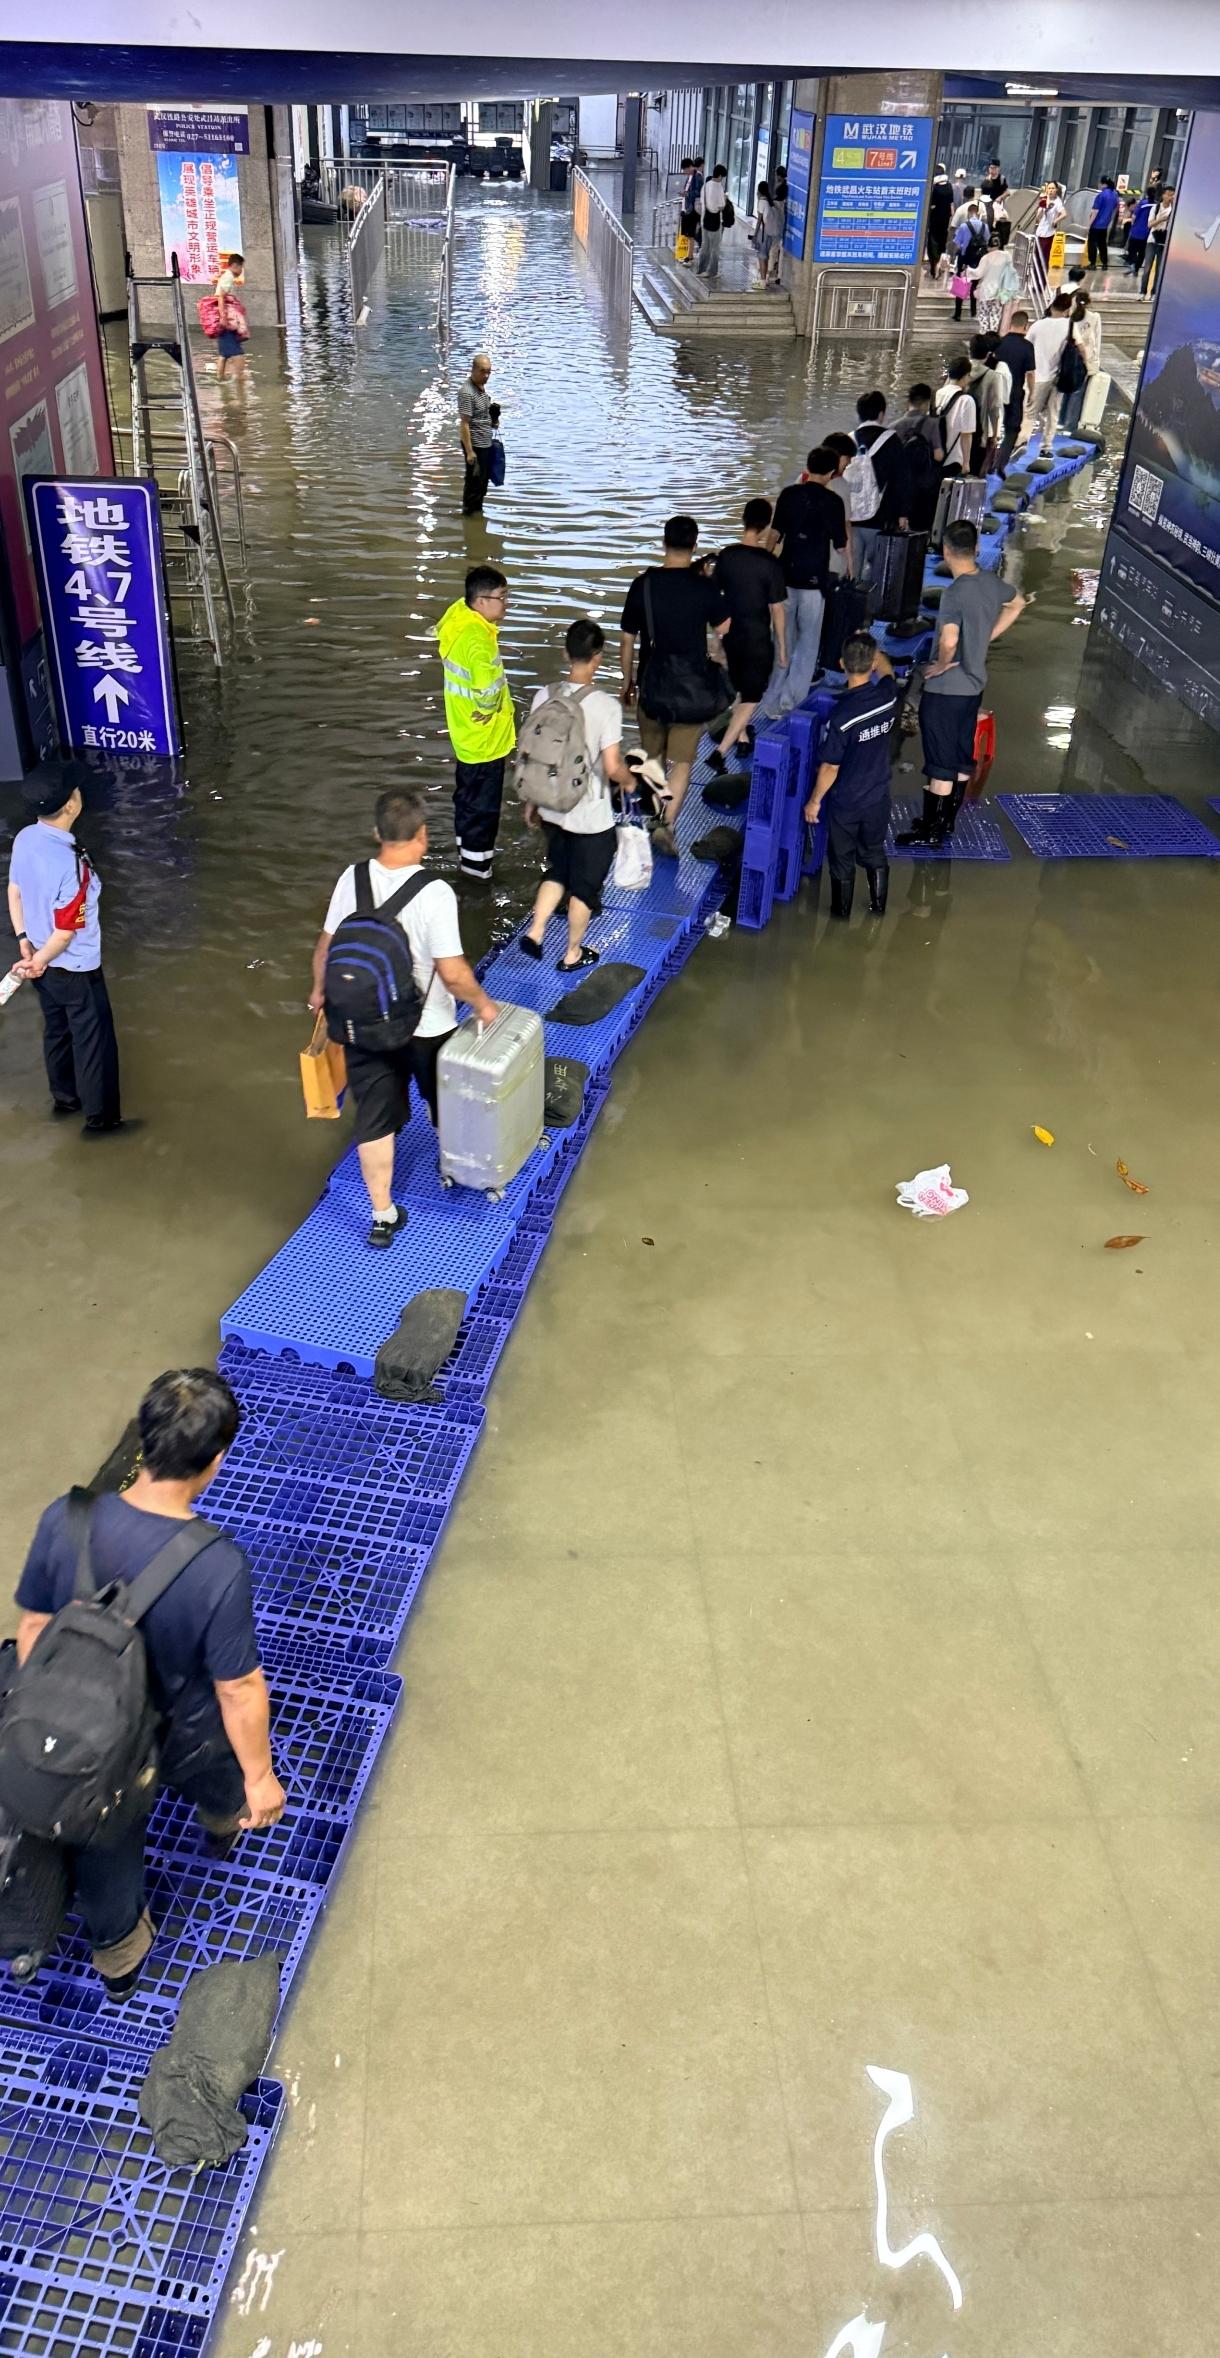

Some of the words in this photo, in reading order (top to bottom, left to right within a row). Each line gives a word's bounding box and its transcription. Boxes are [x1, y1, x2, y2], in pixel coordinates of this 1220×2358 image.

[862, 123, 914, 135] 武汉地铁
[826, 184, 920, 197] 地铁武昌火车站首末班时间
[183, 163, 202, 274] 展现英雄城市文明形象
[201, 164, 220, 275] 倡导乘坐正规营运车辆
[81, 725, 157, 751] 直行20米
